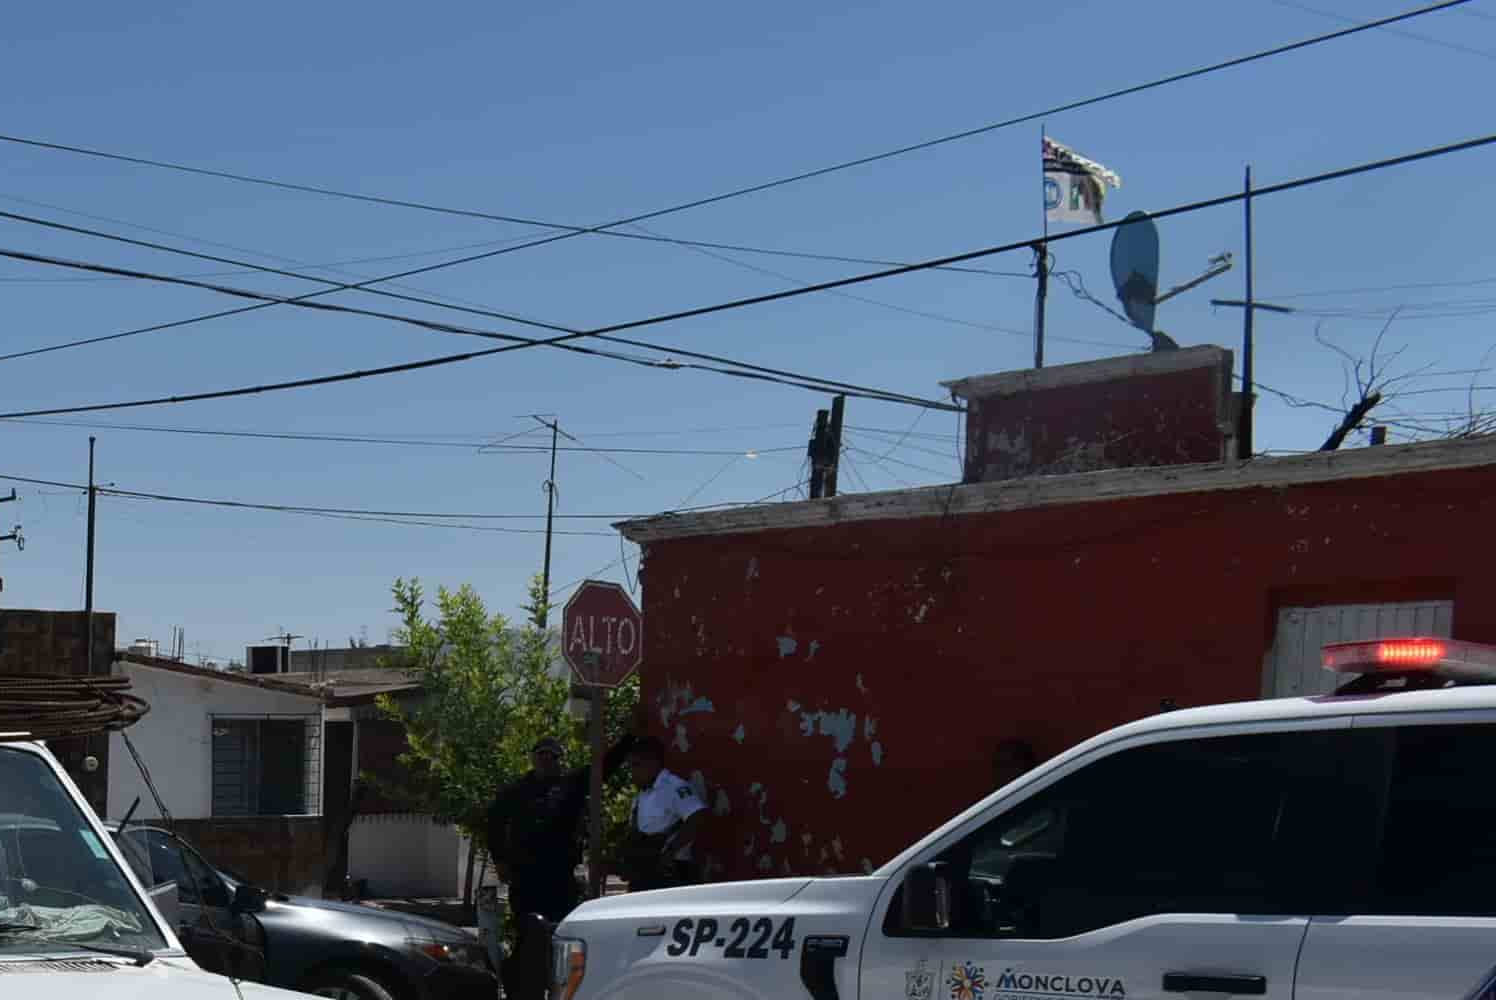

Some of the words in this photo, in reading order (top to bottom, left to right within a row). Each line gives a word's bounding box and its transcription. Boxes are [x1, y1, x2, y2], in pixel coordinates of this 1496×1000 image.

[569, 615, 636, 655] ALTO
[666, 917, 796, 960] SP-224
[996, 970, 1126, 994] MONCLOVA
